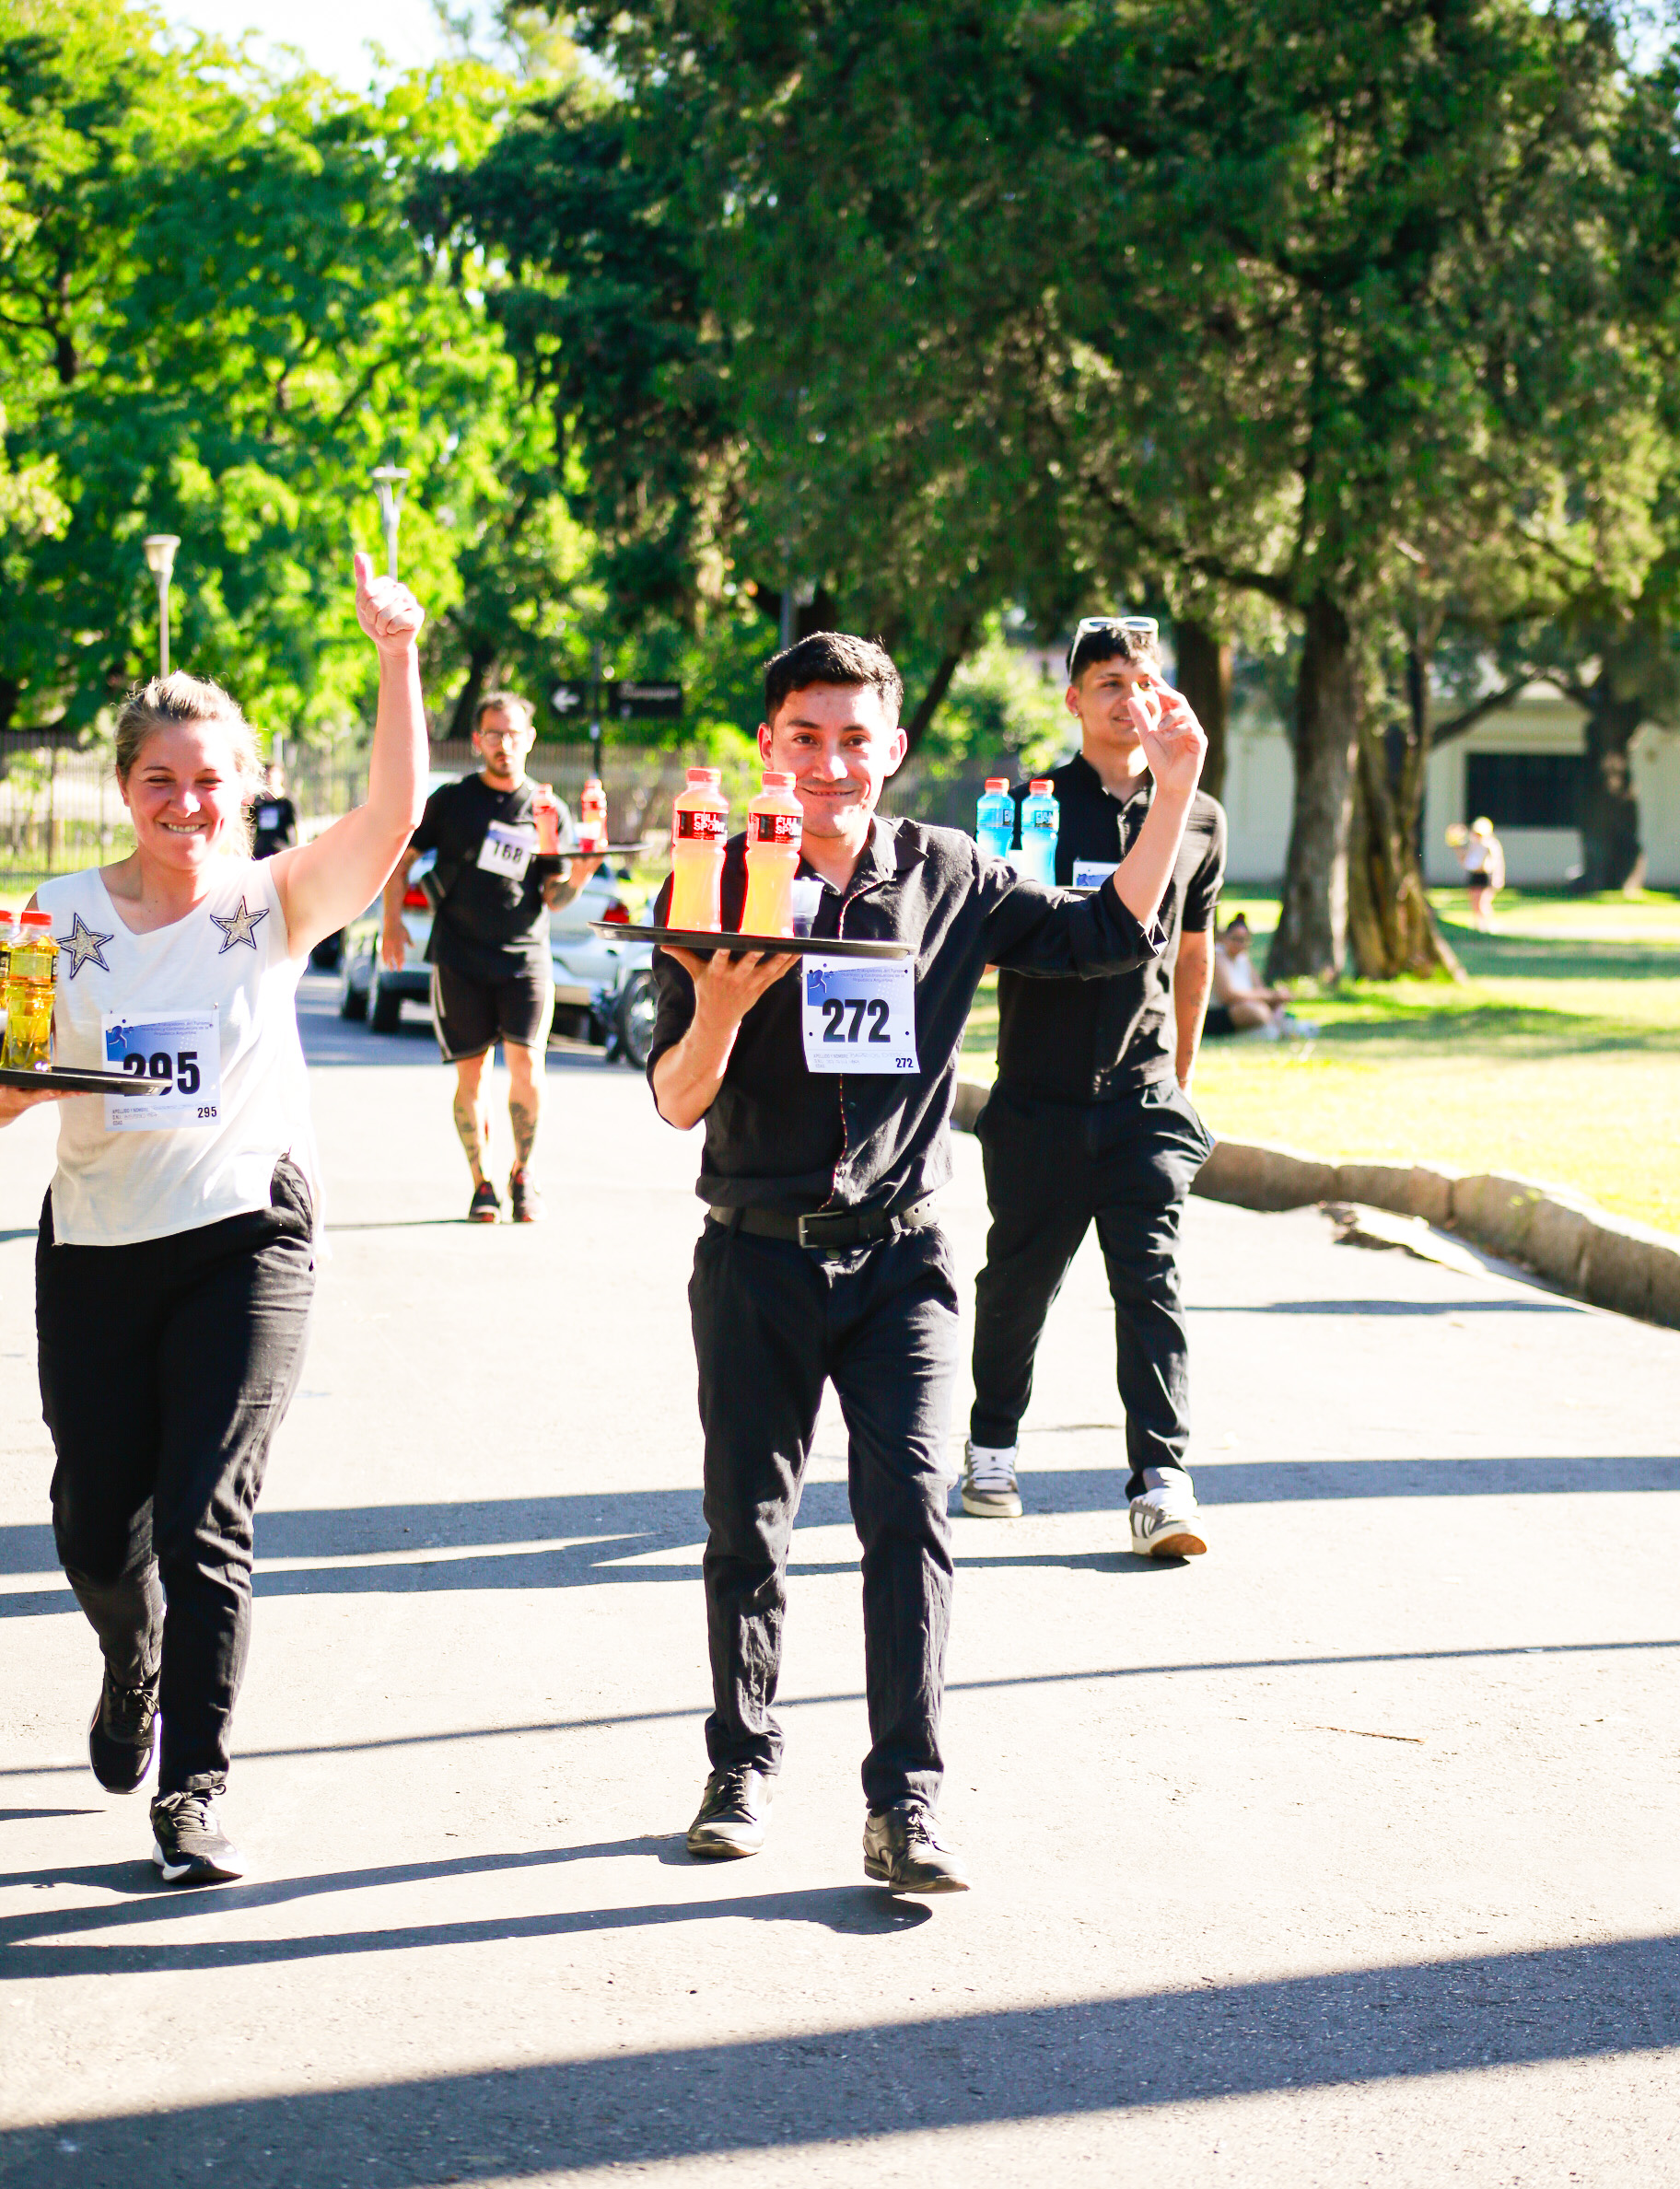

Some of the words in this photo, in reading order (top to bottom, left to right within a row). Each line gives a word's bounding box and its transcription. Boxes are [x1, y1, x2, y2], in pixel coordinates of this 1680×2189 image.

[694, 812, 718, 822] FULL
[492, 840, 523, 864] 168
[822, 997, 891, 1043] 272
[895, 1057, 914, 1068] 272
[122, 1051, 201, 1097] 295
[197, 1106, 217, 1118] 295
